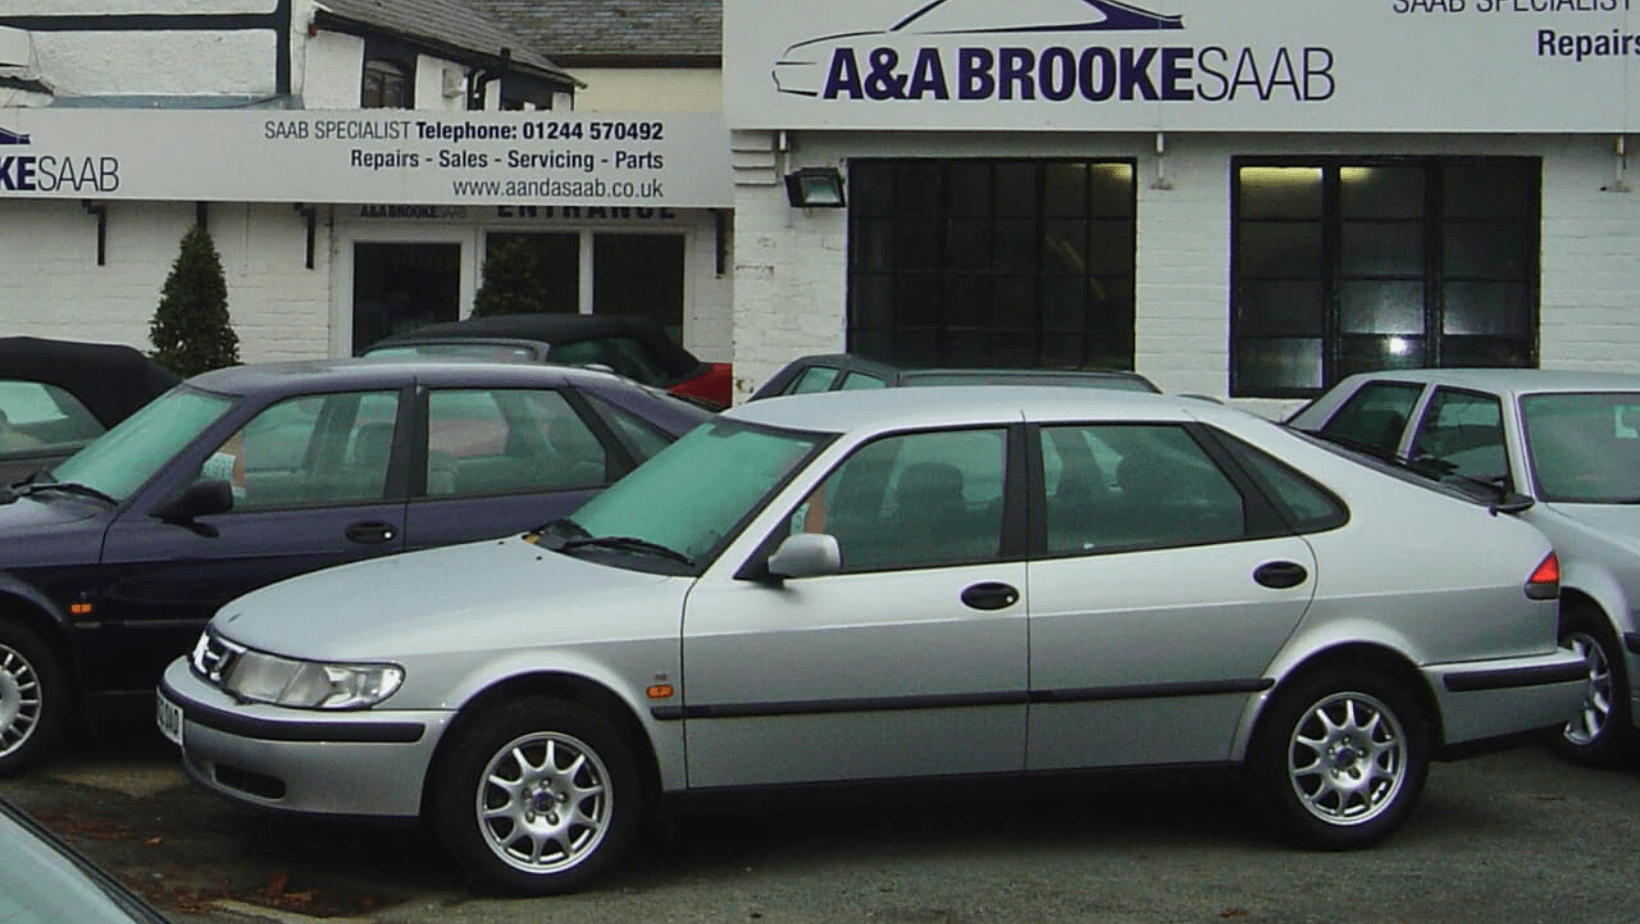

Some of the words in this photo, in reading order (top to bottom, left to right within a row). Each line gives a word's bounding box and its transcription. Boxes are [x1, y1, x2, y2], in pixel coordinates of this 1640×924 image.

[823, 47, 950, 101] A&A
[265, 121, 310, 140] SAAB
[314, 121, 411, 140] SPECIALIST
[416, 121, 518, 143] Telephone:
[523, 122, 584, 140] 01244
[590, 122, 664, 141] 570492
[350, 149, 420, 171] Repairs
[438, 149, 489, 169] Sales
[507, 149, 595, 173] Servicing
[615, 150, 664, 170] Parts
[453, 178, 664, 198] www.aandasaab.co.uk
